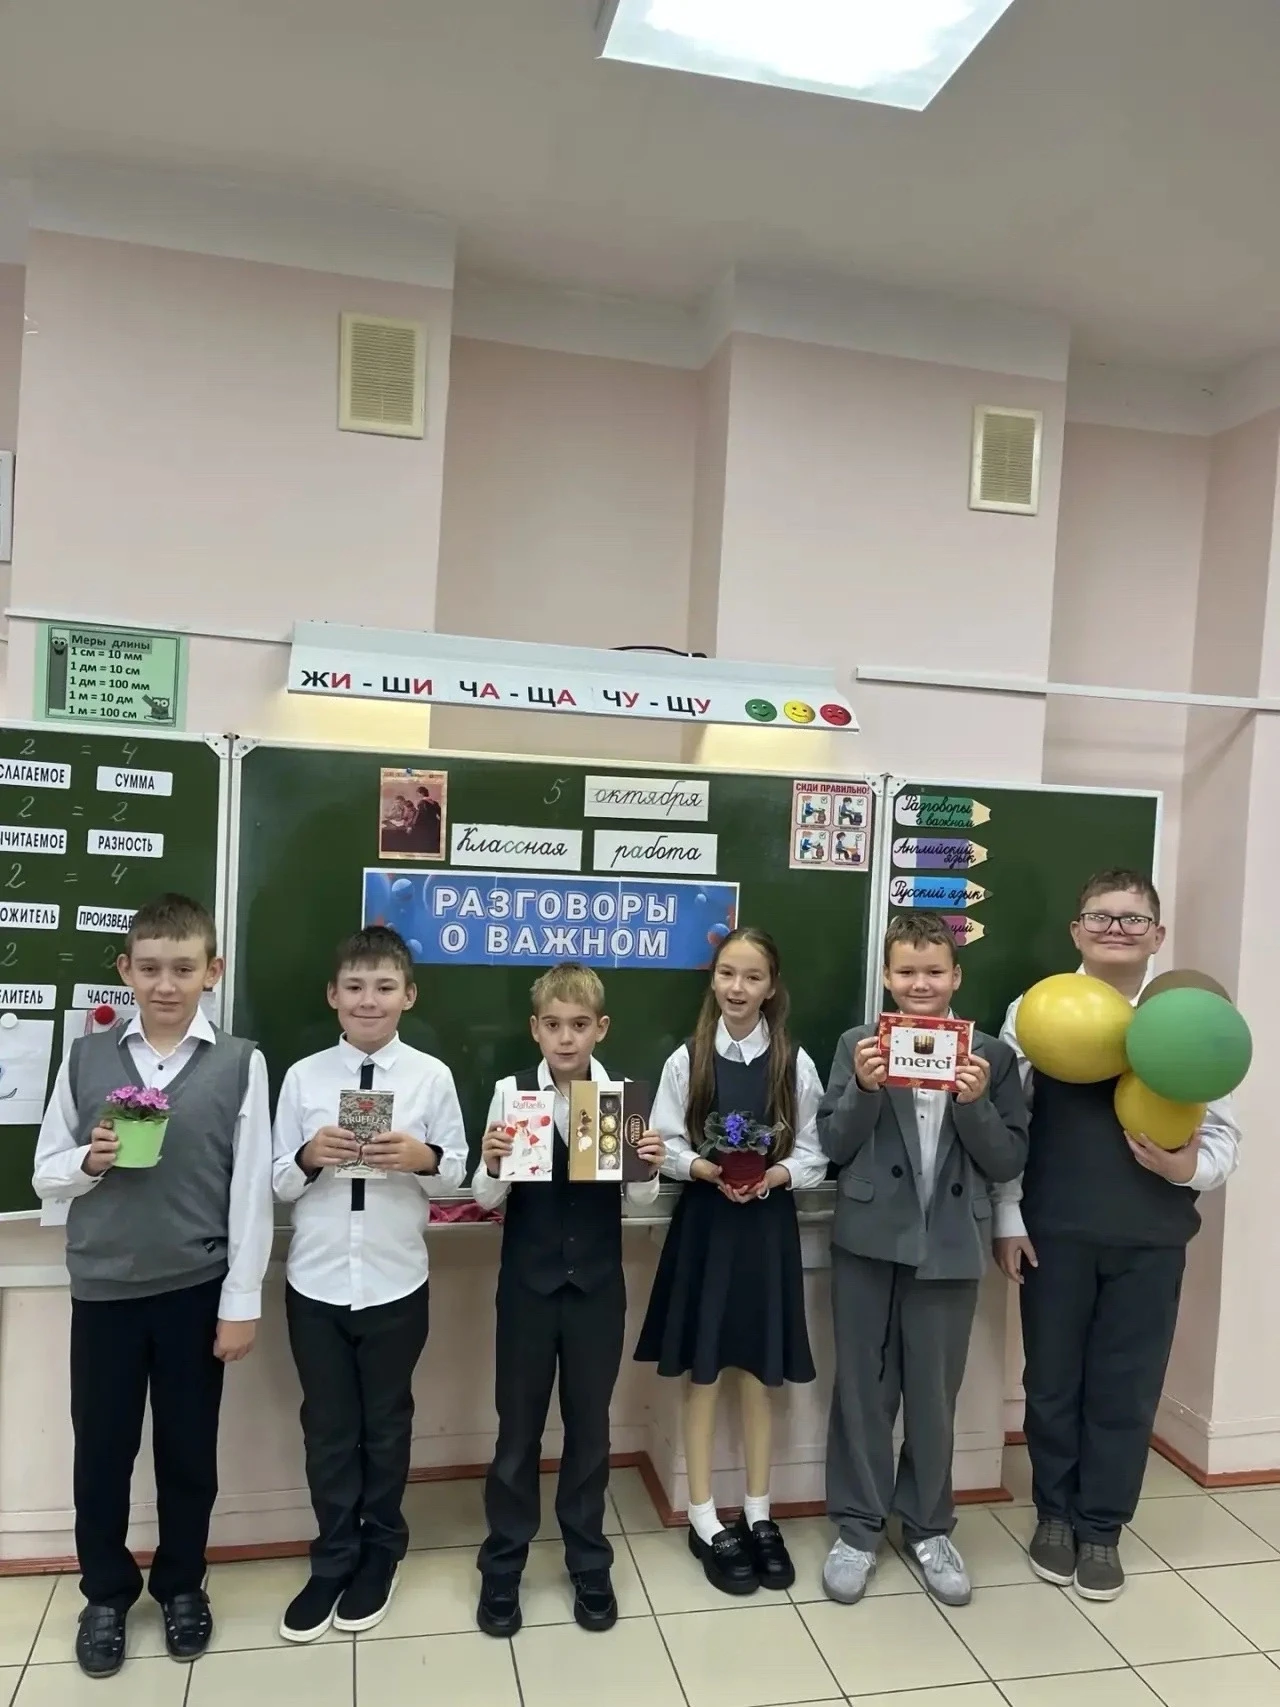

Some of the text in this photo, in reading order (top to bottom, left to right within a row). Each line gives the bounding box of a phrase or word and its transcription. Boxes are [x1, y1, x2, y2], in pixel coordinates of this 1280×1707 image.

[71, 635, 150, 650] Меры длины
[72, 647, 76, 656] 1
[80, 649, 95, 657] см
[108, 650, 121, 659] 10
[124, 653, 142, 661] мм
[70, 662, 76, 670] 1
[79, 663, 96, 672] дм
[109, 665, 123, 674] 10
[125, 667, 140, 675] см
[70, 676, 76, 685] 1
[79, 678, 96, 688] дм
[109, 679, 128, 689] 100
[131, 682, 150, 691] мм
[69, 691, 75, 700] 1
[100, 693, 114, 702] 10
[116, 695, 133, 704] дм
[301, 670, 351, 689] ЖИ
[382, 676, 433, 696] ШИ
[459, 680, 500, 700] ЧА
[528, 686, 577, 707] ЩА
[602, 689, 640, 708] ЧУ
[667, 695, 711, 717] ЩУ
[69, 706, 74, 714] 1
[100, 708, 120, 718] 100
[19, 738, 138, 764] 2 = 4
[115, 772, 155, 790] СУММА
[796, 783, 870, 794] СИДИ ПРАВИЛЬНО!
[543, 778, 703, 816] 5 октября
[17, 796, 128, 822] 2 = 2
[901, 794, 972, 821] Разговоры
[926, 812, 974, 827] важном
[0, 831, 153, 852] ЧИТАЕМОЕ РАЗНОСТЬ
[456, 826, 702, 868] Классная работа
[894, 838, 974, 855] Английский
[944, 854, 976, 869] язык
[4, 862, 128, 888] 2 = 4
[891, 880, 982, 905] Русский язык
[432, 887, 676, 924] РАЗГОВОРЫ
[440, 924, 668, 958] О ВАЖНОМ
[0, 942, 117, 969] 2 = 2
[0, 990, 43, 1004] ЛИТЕЛЬ
[895, 1056, 952, 1070] merci
[512, 1100, 546, 1110] Raffaello
